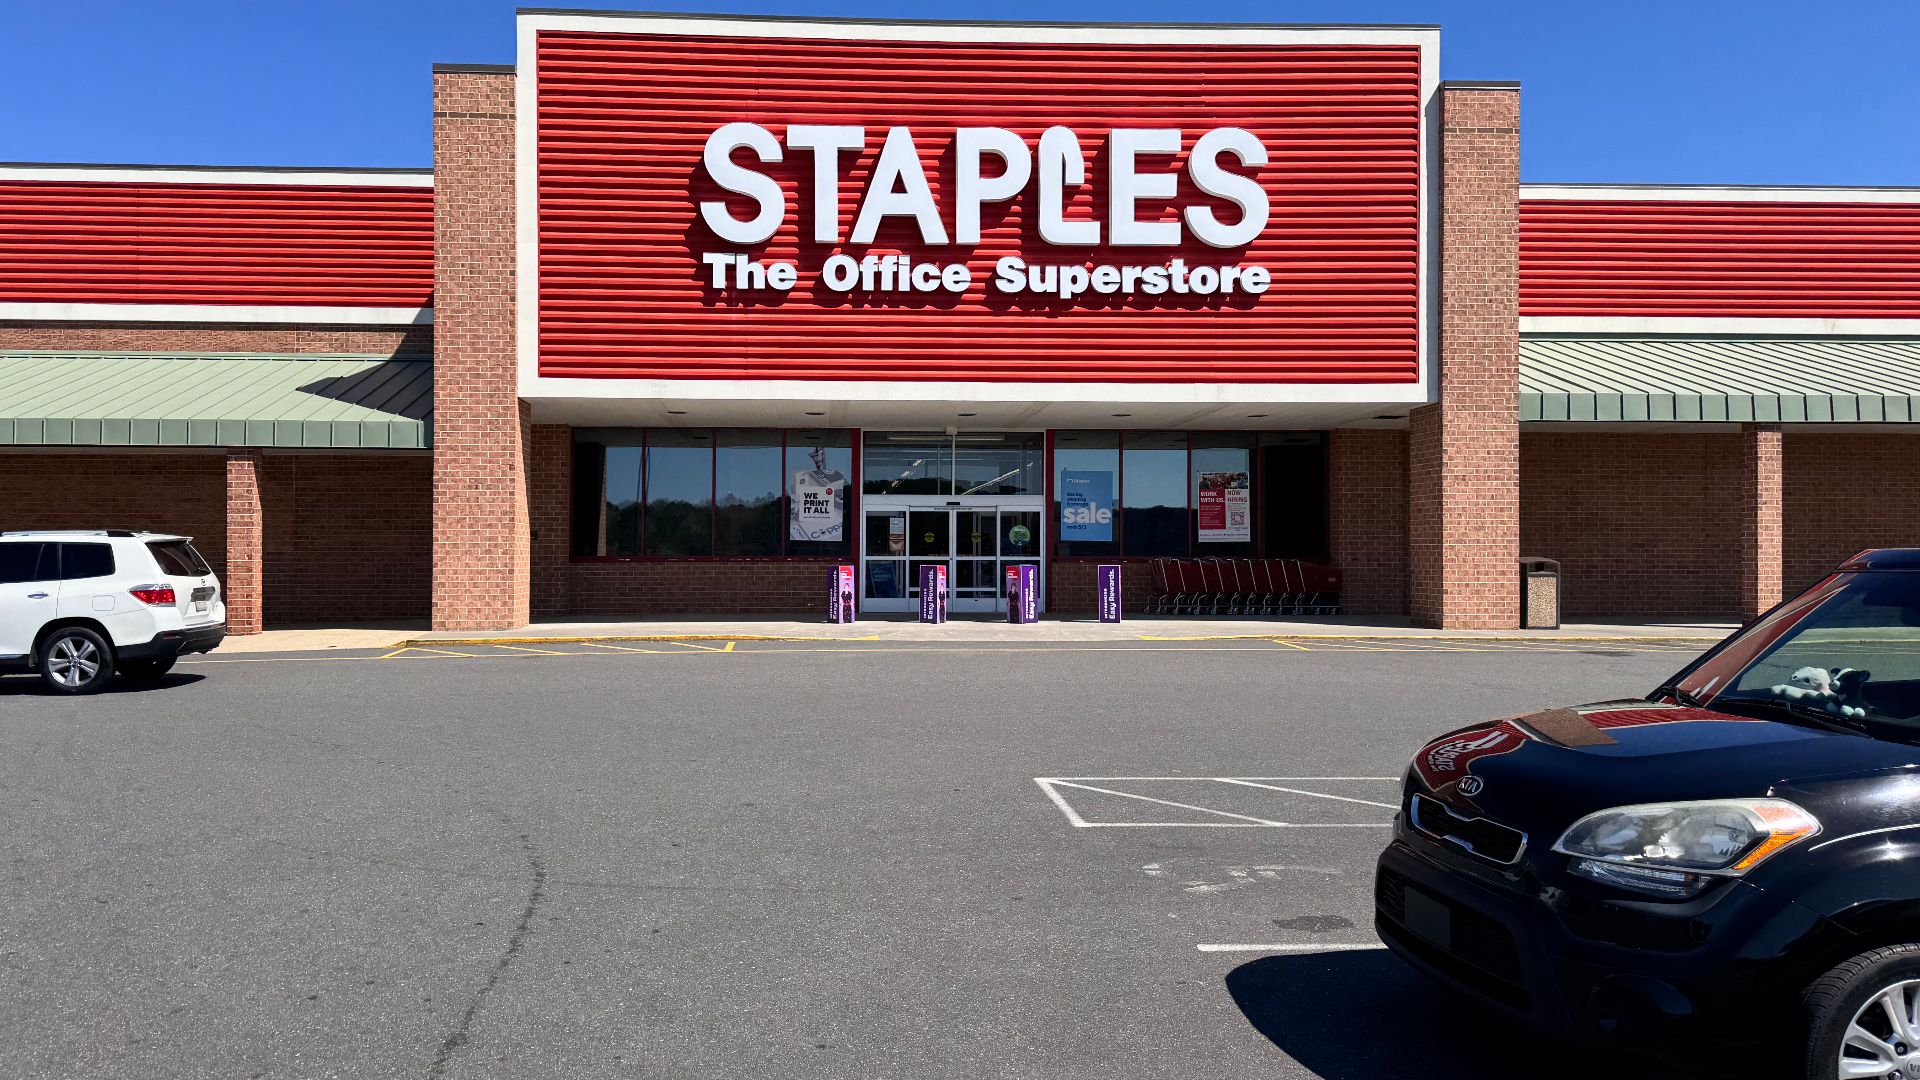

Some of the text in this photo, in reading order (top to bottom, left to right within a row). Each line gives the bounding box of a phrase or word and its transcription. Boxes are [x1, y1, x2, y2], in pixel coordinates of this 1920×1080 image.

[700, 122, 1271, 248] STAPLES
[703, 252, 1271, 299] The Office Superstore
[1063, 502, 1112, 524] sale
[1458, 777, 1478, 793] KIA
